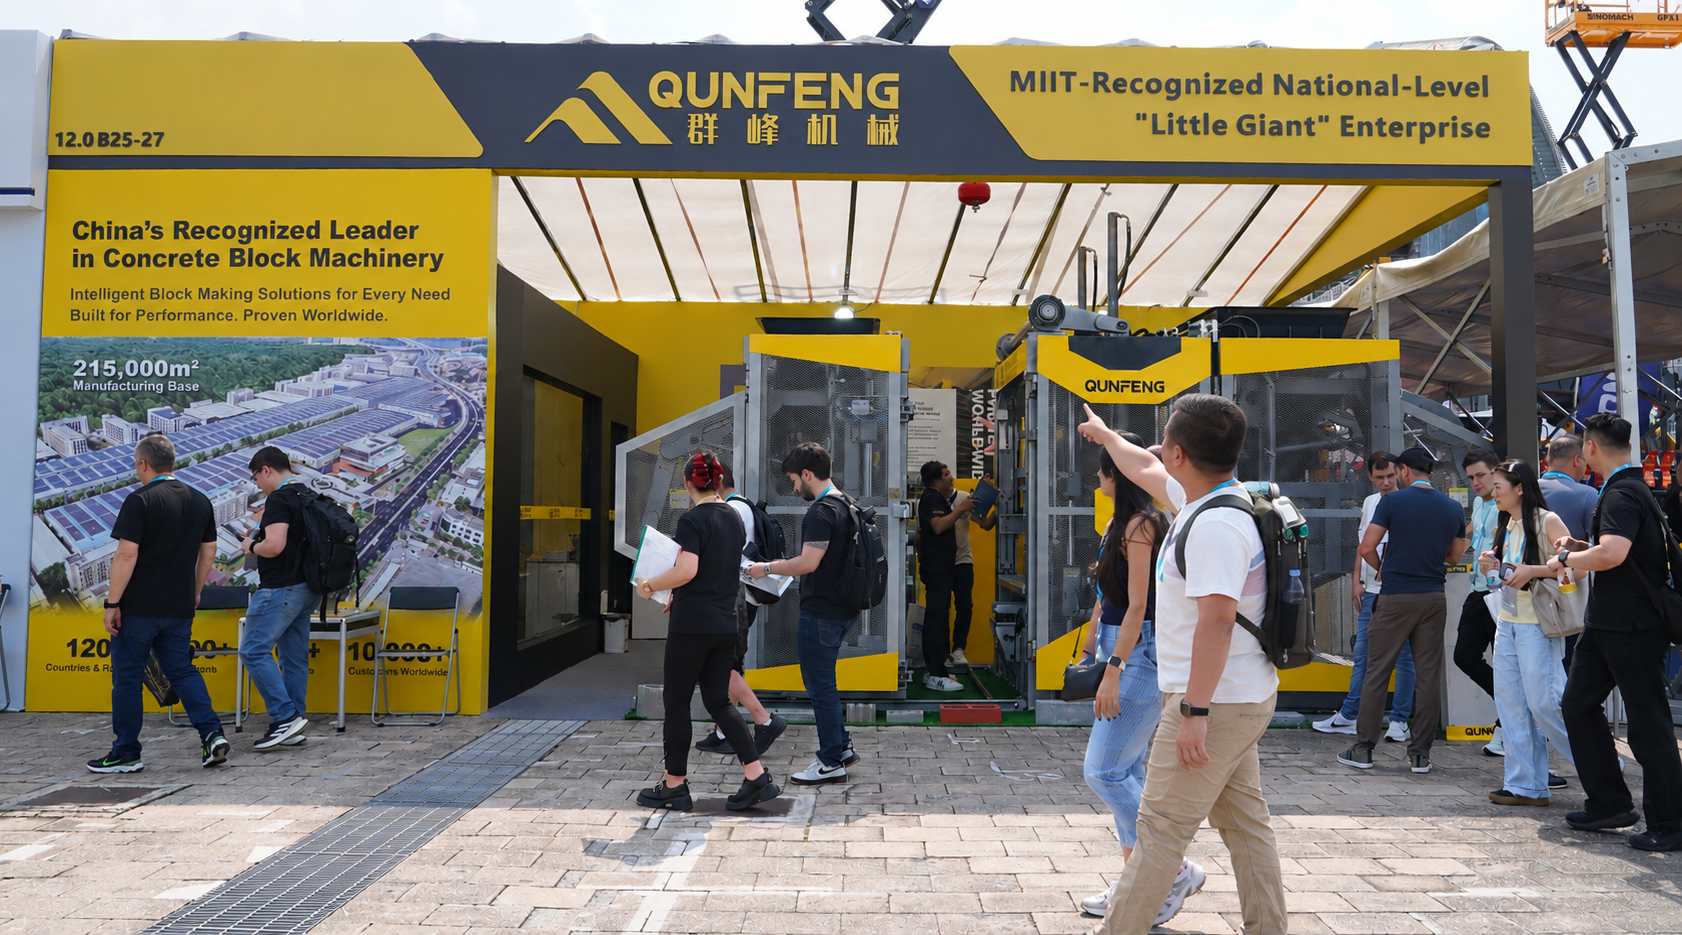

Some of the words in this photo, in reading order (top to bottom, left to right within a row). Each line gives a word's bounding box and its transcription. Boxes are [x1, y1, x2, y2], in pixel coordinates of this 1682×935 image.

[649, 71, 899, 109] QUNFENG
[1011, 71, 1262, 101] MIIT-Recognized
[1274, 74, 1488, 97] National-Level
[688, 113, 899, 145] 群峰机械
[1136, 112, 1227, 135] "Little
[1236, 114, 1329, 136] Giant"
[1341, 115, 1490, 144] Enterprise
[55, 132, 94, 147] 12.0
[98, 132, 164, 147] B25-27
[73, 221, 163, 240] China’s
[174, 220, 320, 244] Recognized
[330, 220, 419, 239] Leader
[73, 249, 93, 267] in
[104, 248, 219, 267] Concrete
[230, 248, 300, 267] Block
[310, 248, 444, 272] Machinery
[71, 288, 144, 303] Intelligent
[150, 288, 192, 300] Block
[199, 288, 252, 303] Making
[259, 288, 330, 300] Solutions
[337, 288, 357, 300] for
[363, 288, 406, 303] Every
[412, 288, 450, 300] Need
[71, 309, 105, 321] Built
[110, 309, 131, 321] for
[136, 309, 237, 321] Performance.
[244, 309, 296, 321] Proven
[302, 309, 387, 321] Worldwide.
[73, 380, 164, 394] Manufacturing
[168, 380, 200, 392] Base
[1085, 379, 1165, 393] QUNFENG
[348, 641, 444, 662] 10000+
[45, 663, 91, 672] Countries
[93, 663, 100, 673] &
[400, 668, 449, 677] Worldwide
